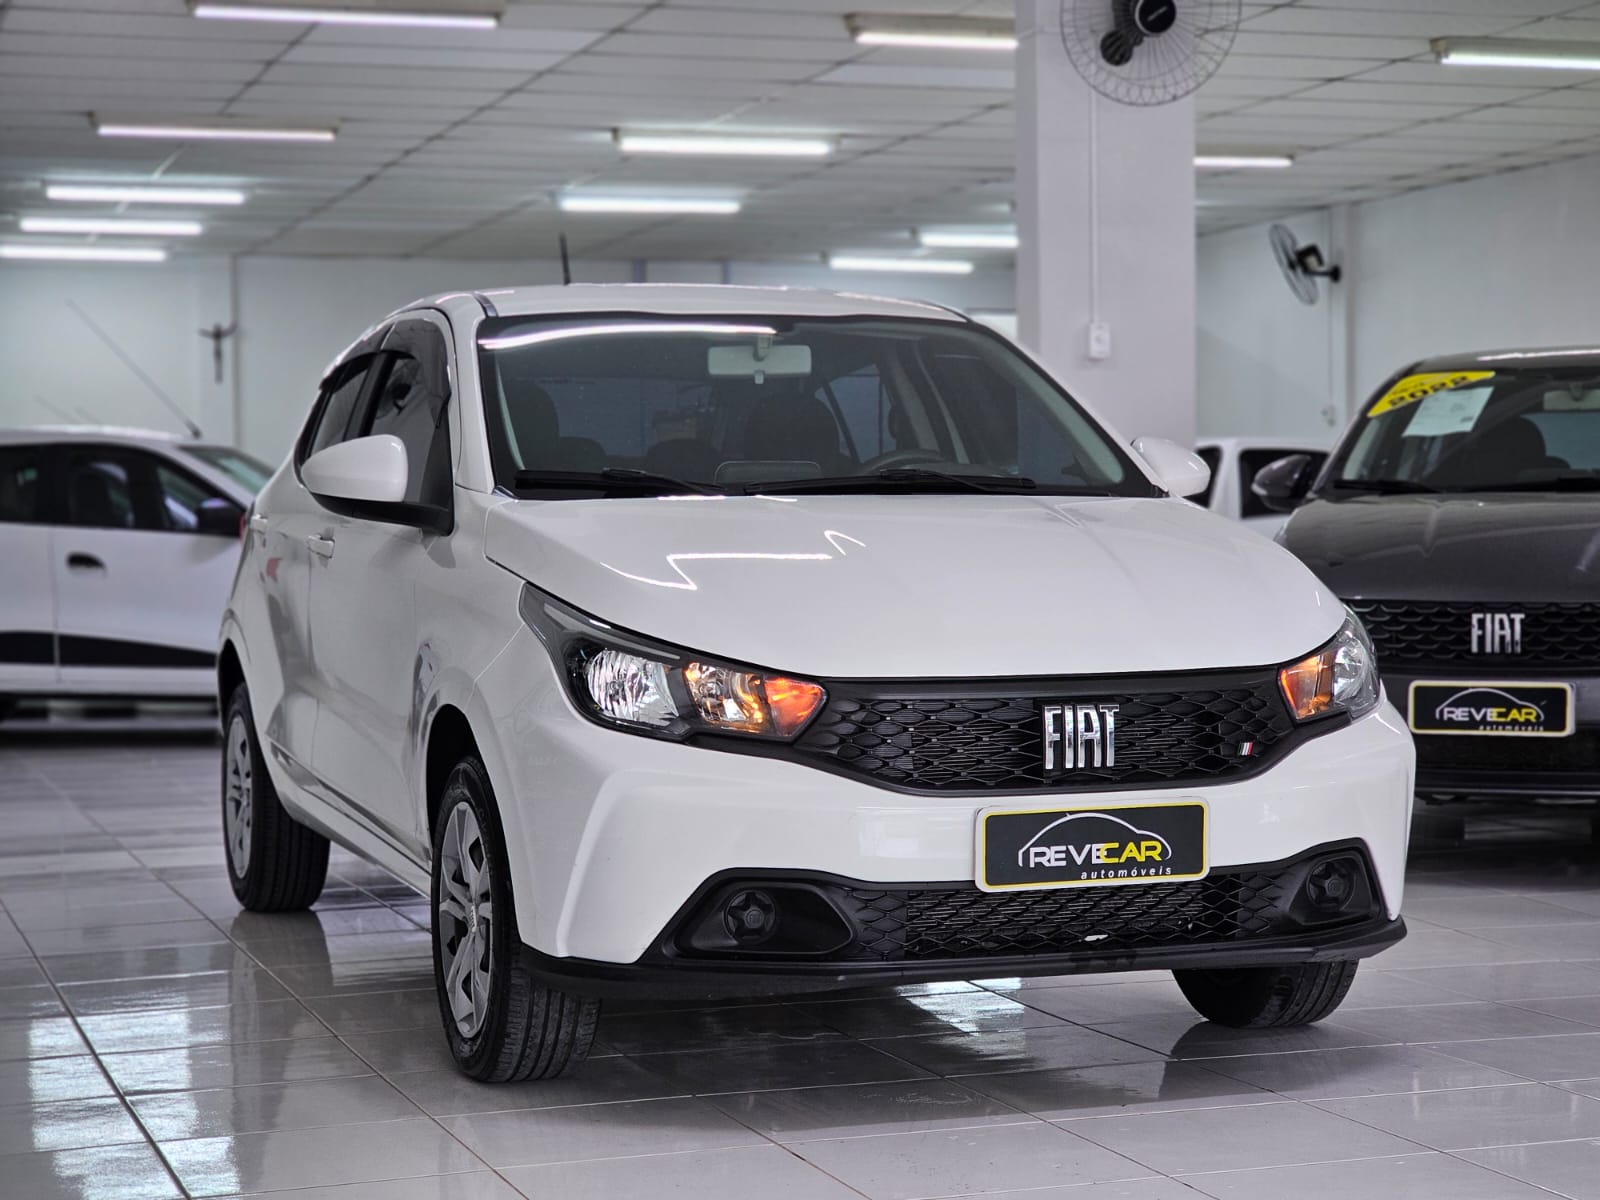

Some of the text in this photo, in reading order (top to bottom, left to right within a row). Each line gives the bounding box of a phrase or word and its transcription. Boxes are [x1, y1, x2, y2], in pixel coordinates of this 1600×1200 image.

[1471, 613, 1525, 653] FIAT
[1443, 707, 1537, 722] REVECAR
[1044, 704, 1119, 769] FIAT
[1029, 840, 1162, 868] REVECAR
[1081, 866, 1172, 880] automóveis
